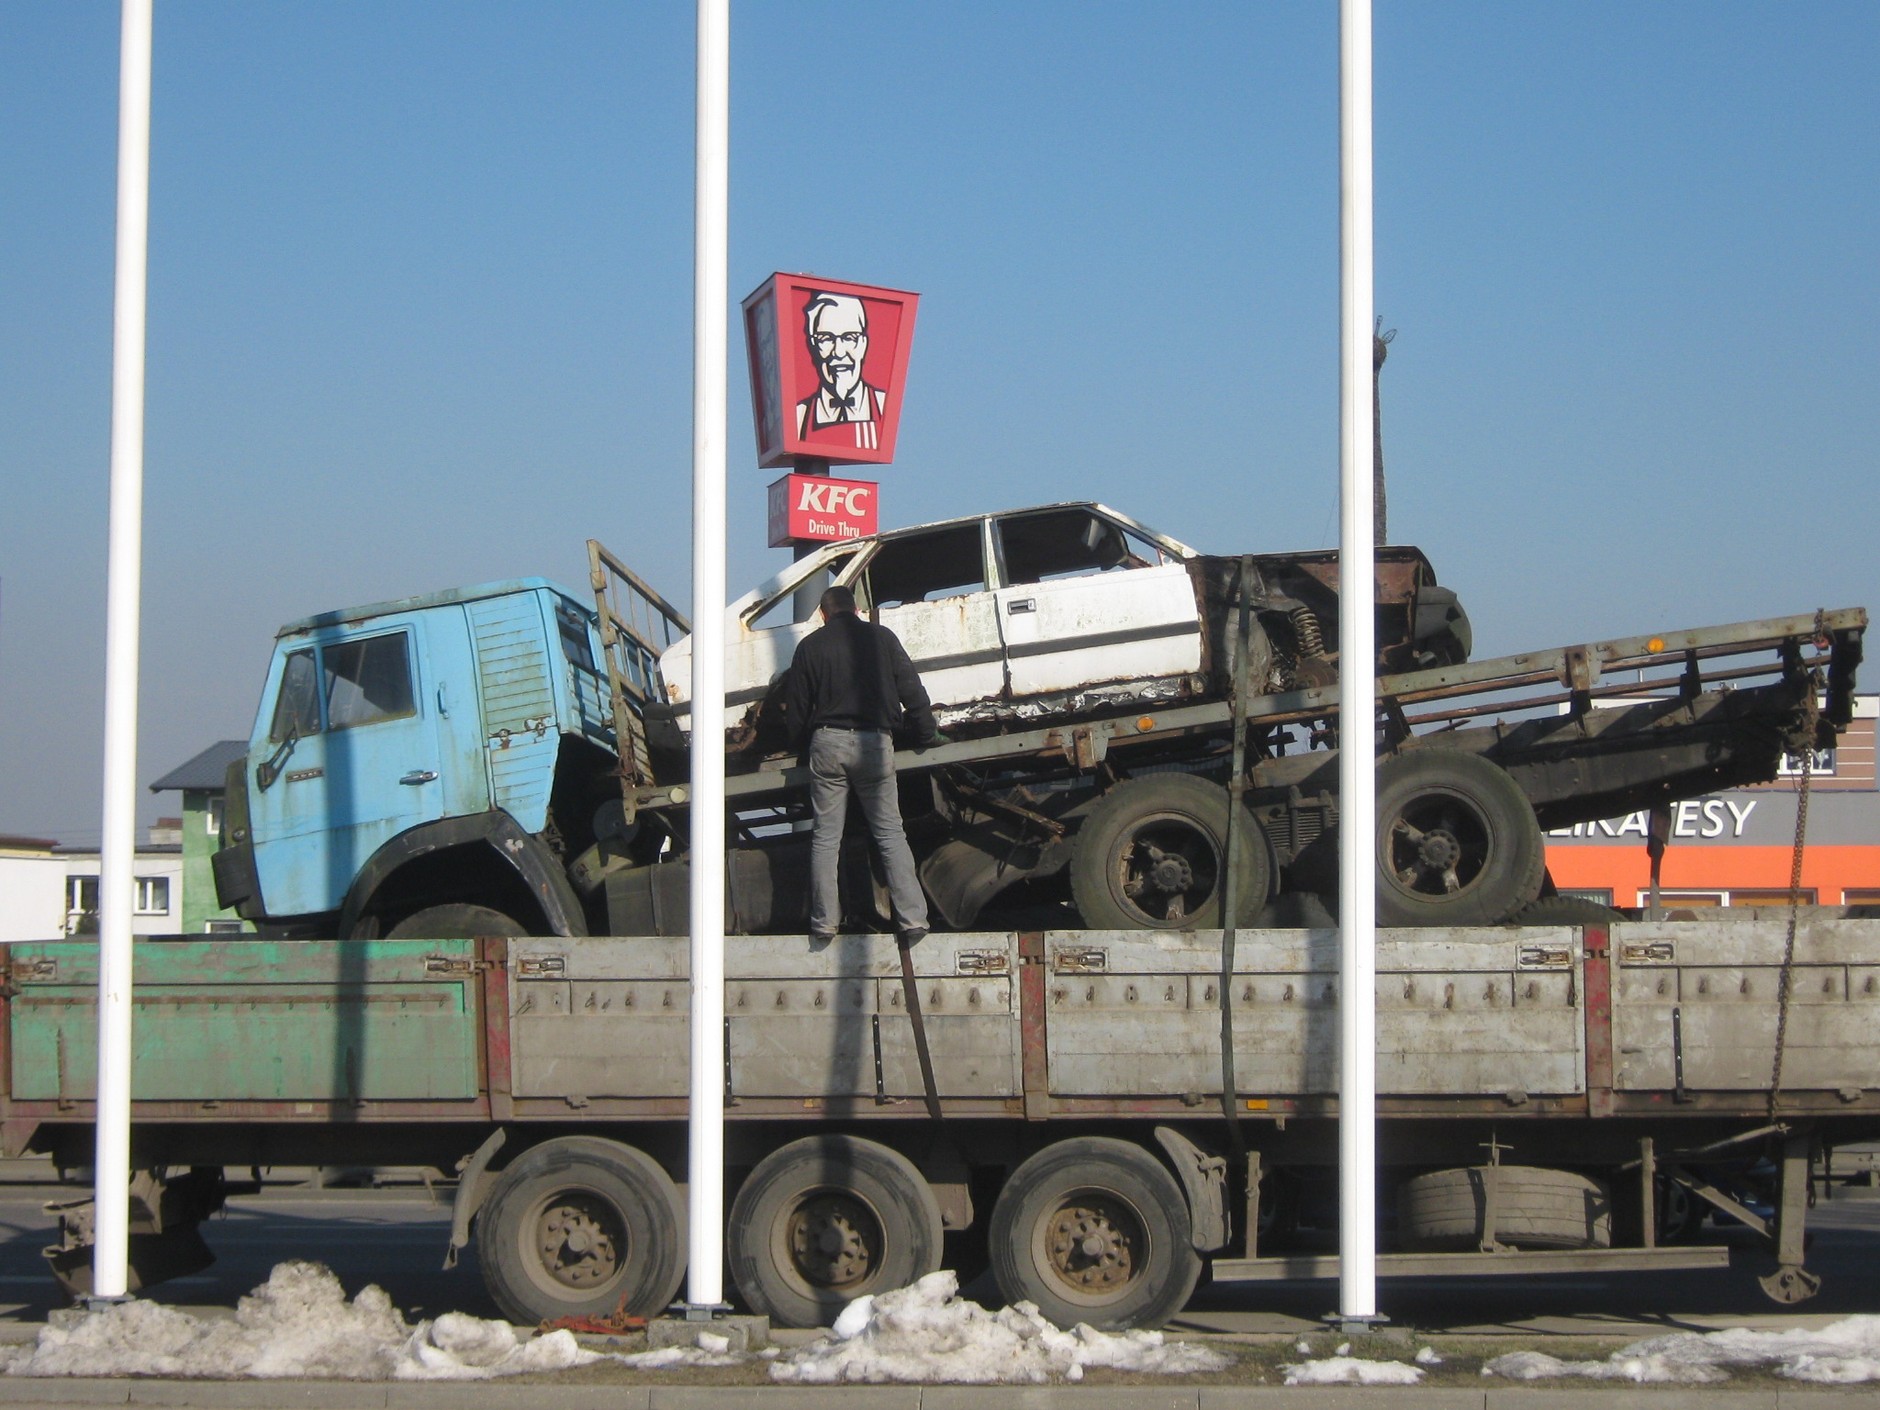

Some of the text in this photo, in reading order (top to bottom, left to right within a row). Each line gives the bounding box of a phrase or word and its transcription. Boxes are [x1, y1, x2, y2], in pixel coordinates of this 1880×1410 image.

[797, 482, 868, 516] KFC
[808, 518, 860, 537] Drive Thru
